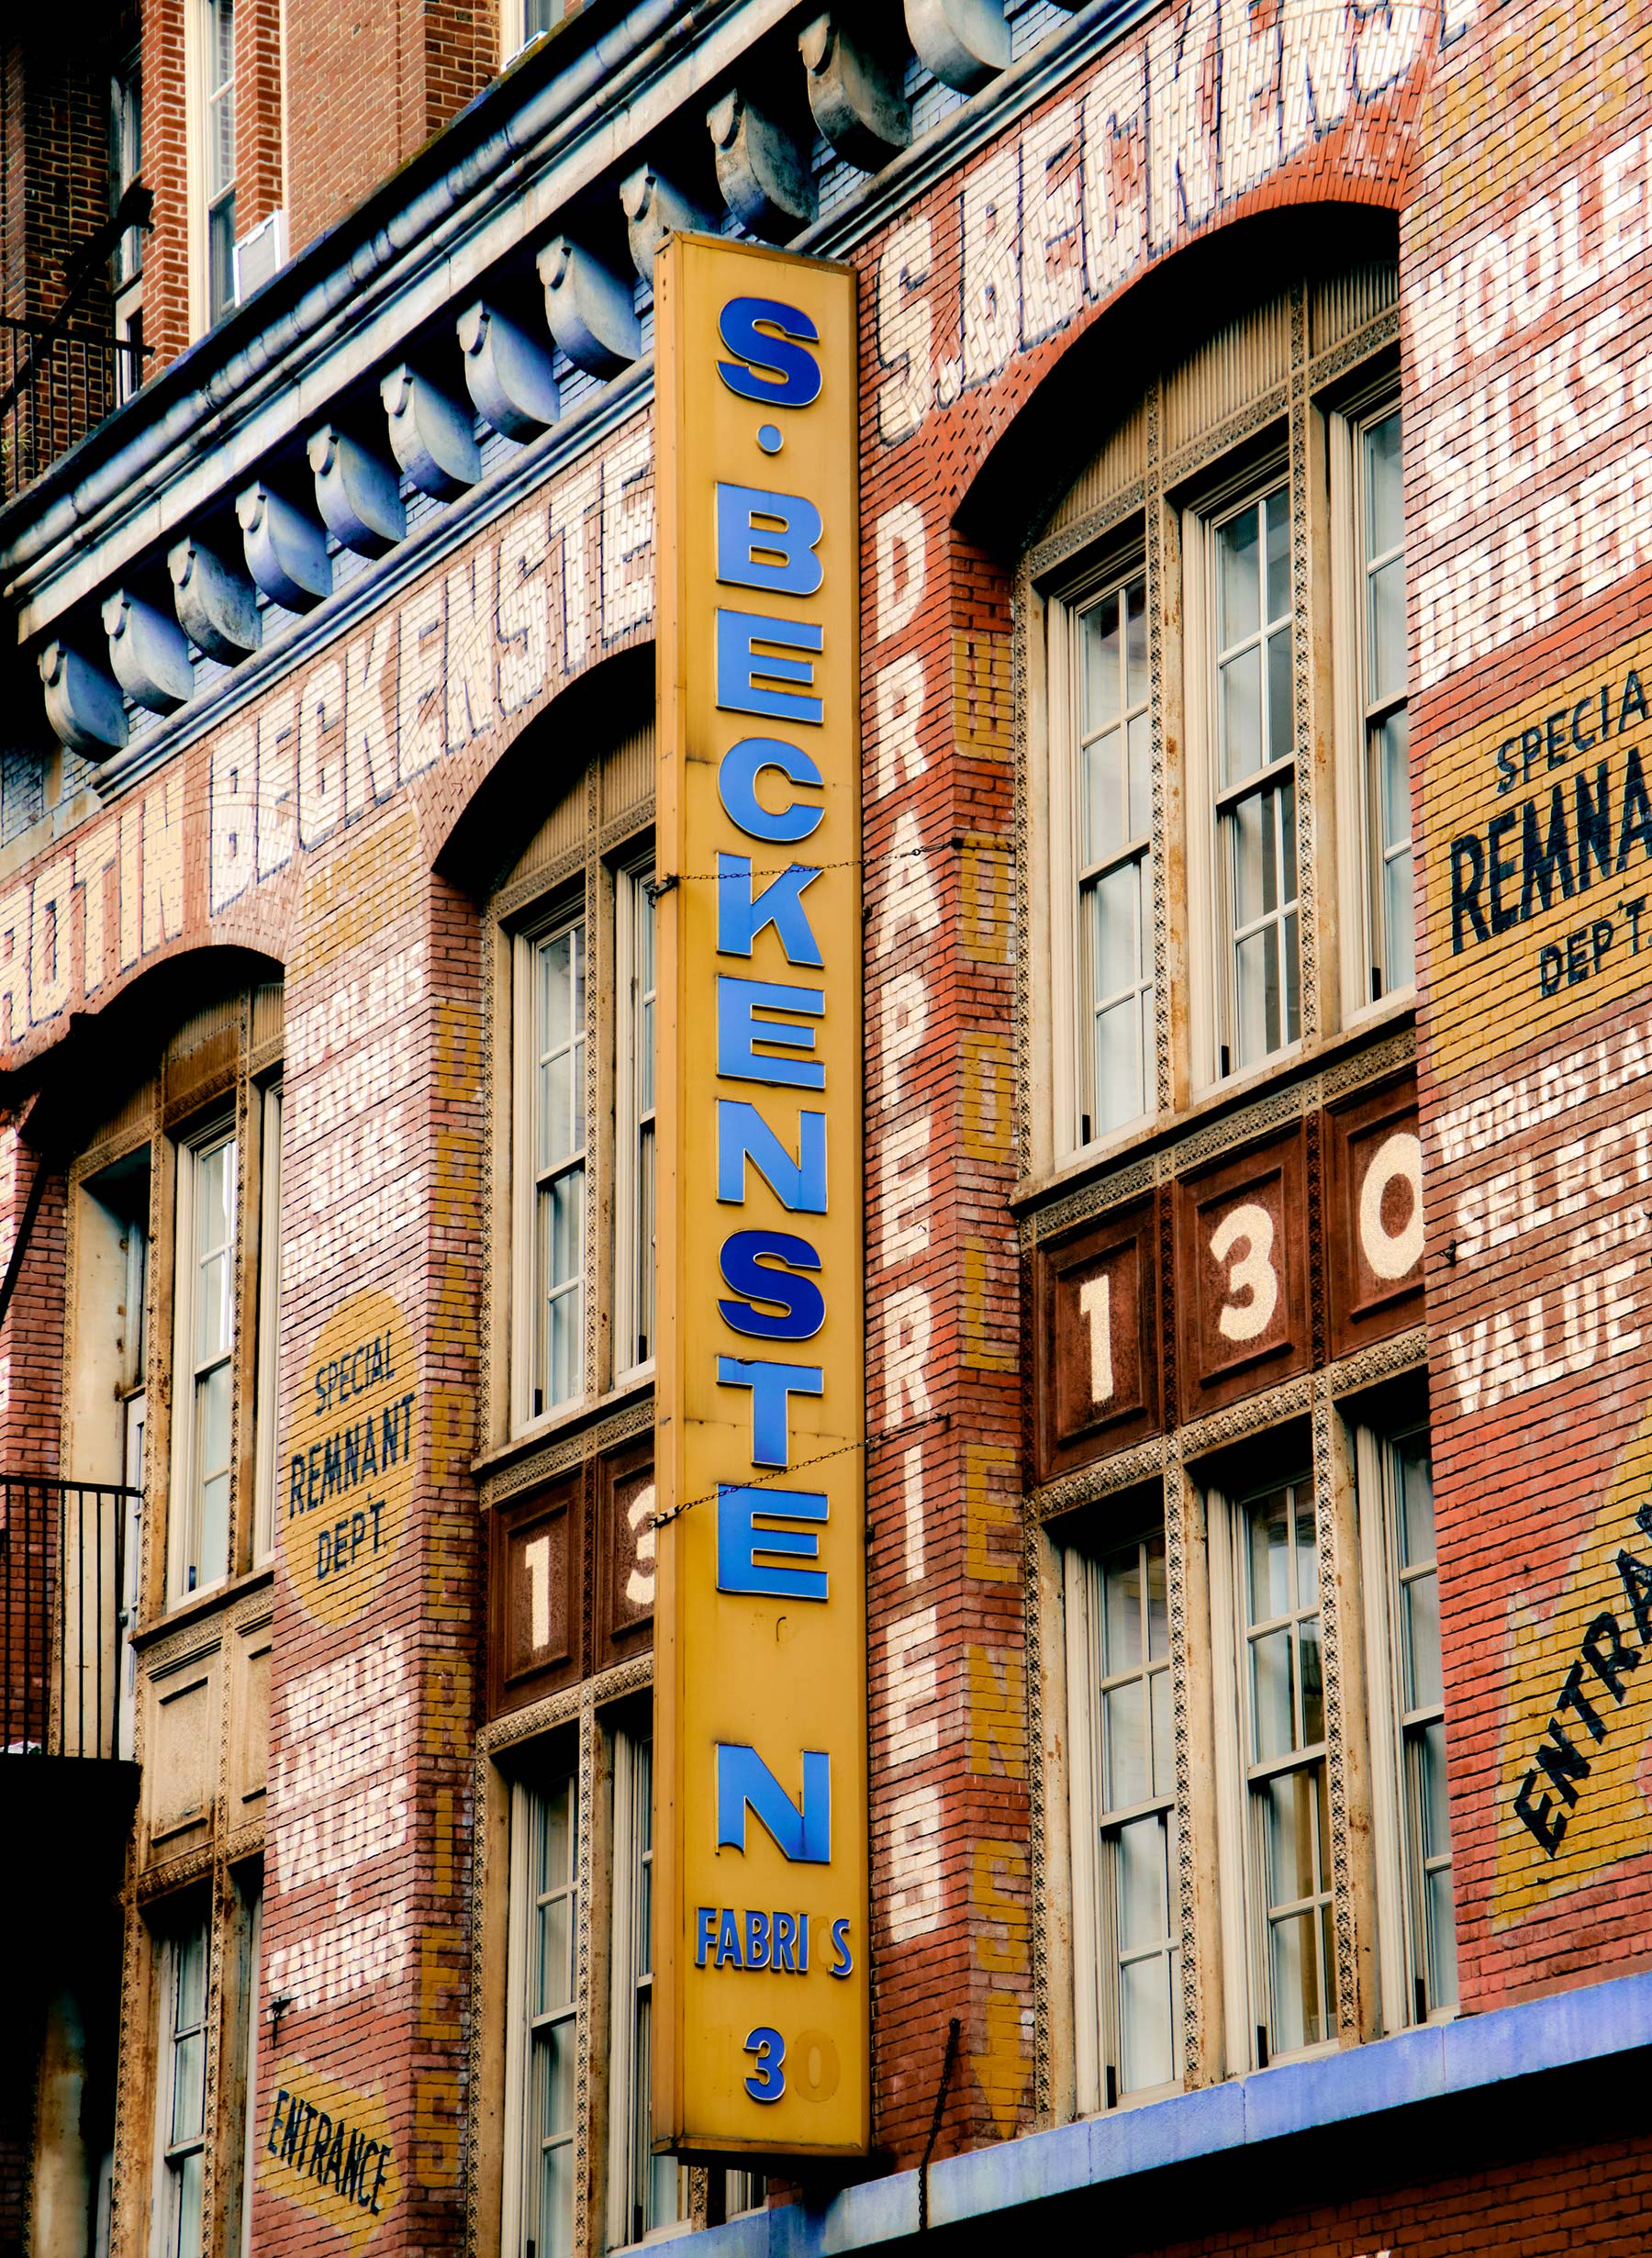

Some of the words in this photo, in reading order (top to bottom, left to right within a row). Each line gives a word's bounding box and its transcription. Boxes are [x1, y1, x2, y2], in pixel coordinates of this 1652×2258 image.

[1495, 669, 1649, 794] SPECIA
[1450, 745, 1652, 956] REMNA
[1598, 1017, 1652, 1095] LA
[309, 1106, 402, 1213] SILKS
[873, 500, 943, 1944] DRAPERIES
[1079, 1133, 1425, 1404] 130
[314, 1329, 395, 1416] SPECIAL
[289, 1392, 415, 1519] REMNANT
[417, 1000, 483, 2188] DRAPERIES
[277, 1694, 409, 1810] LARGEST
[267, 2088, 393, 2216] ENTRANCE
